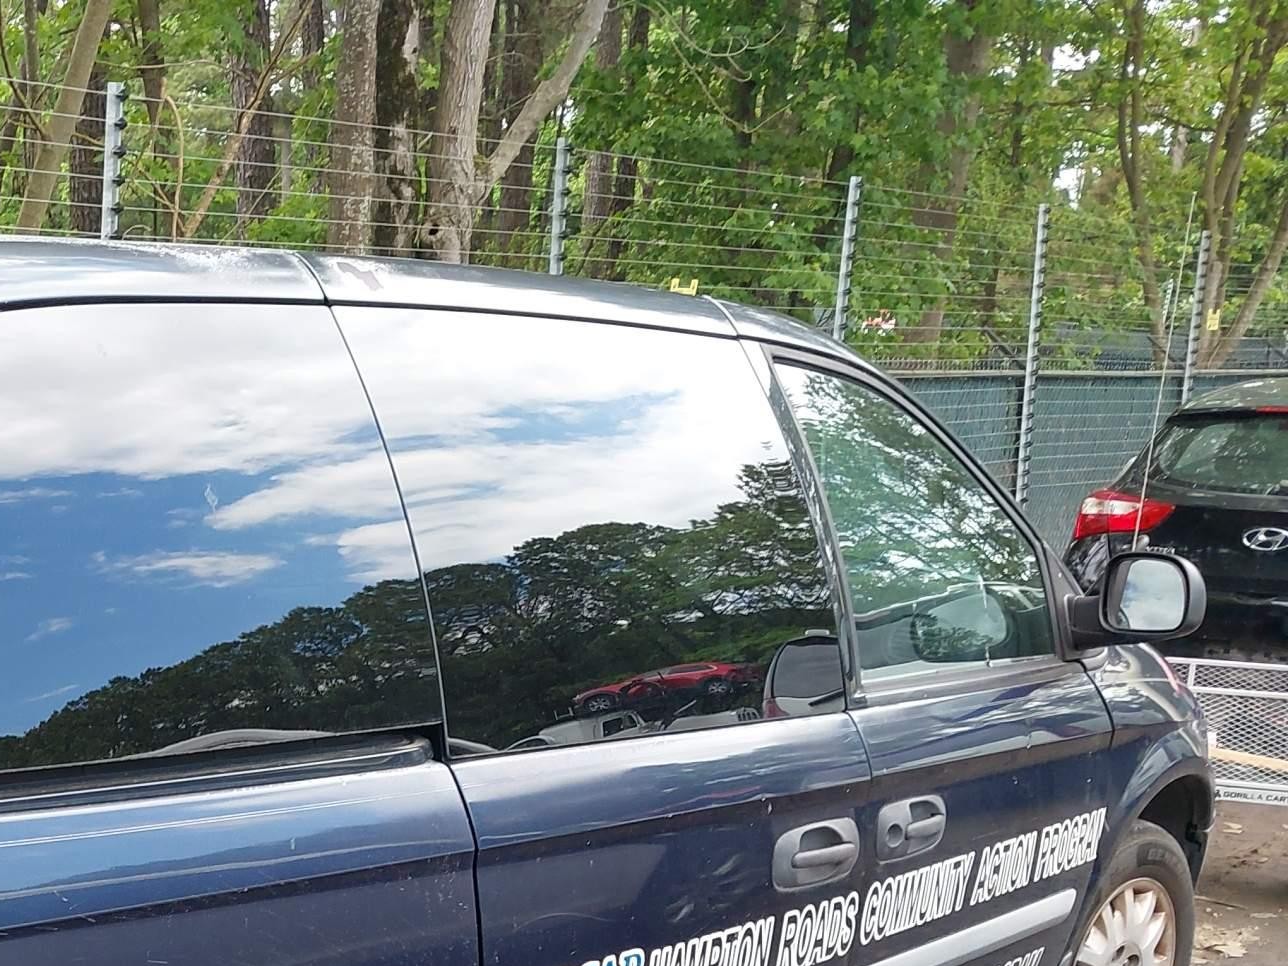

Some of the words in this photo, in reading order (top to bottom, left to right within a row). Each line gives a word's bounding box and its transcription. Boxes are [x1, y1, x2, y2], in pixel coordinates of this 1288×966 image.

[1223, 791, 1263, 800] GORILLA
[860, 850, 976, 946] COMMUNITY
[969, 831, 1038, 906] ACTION
